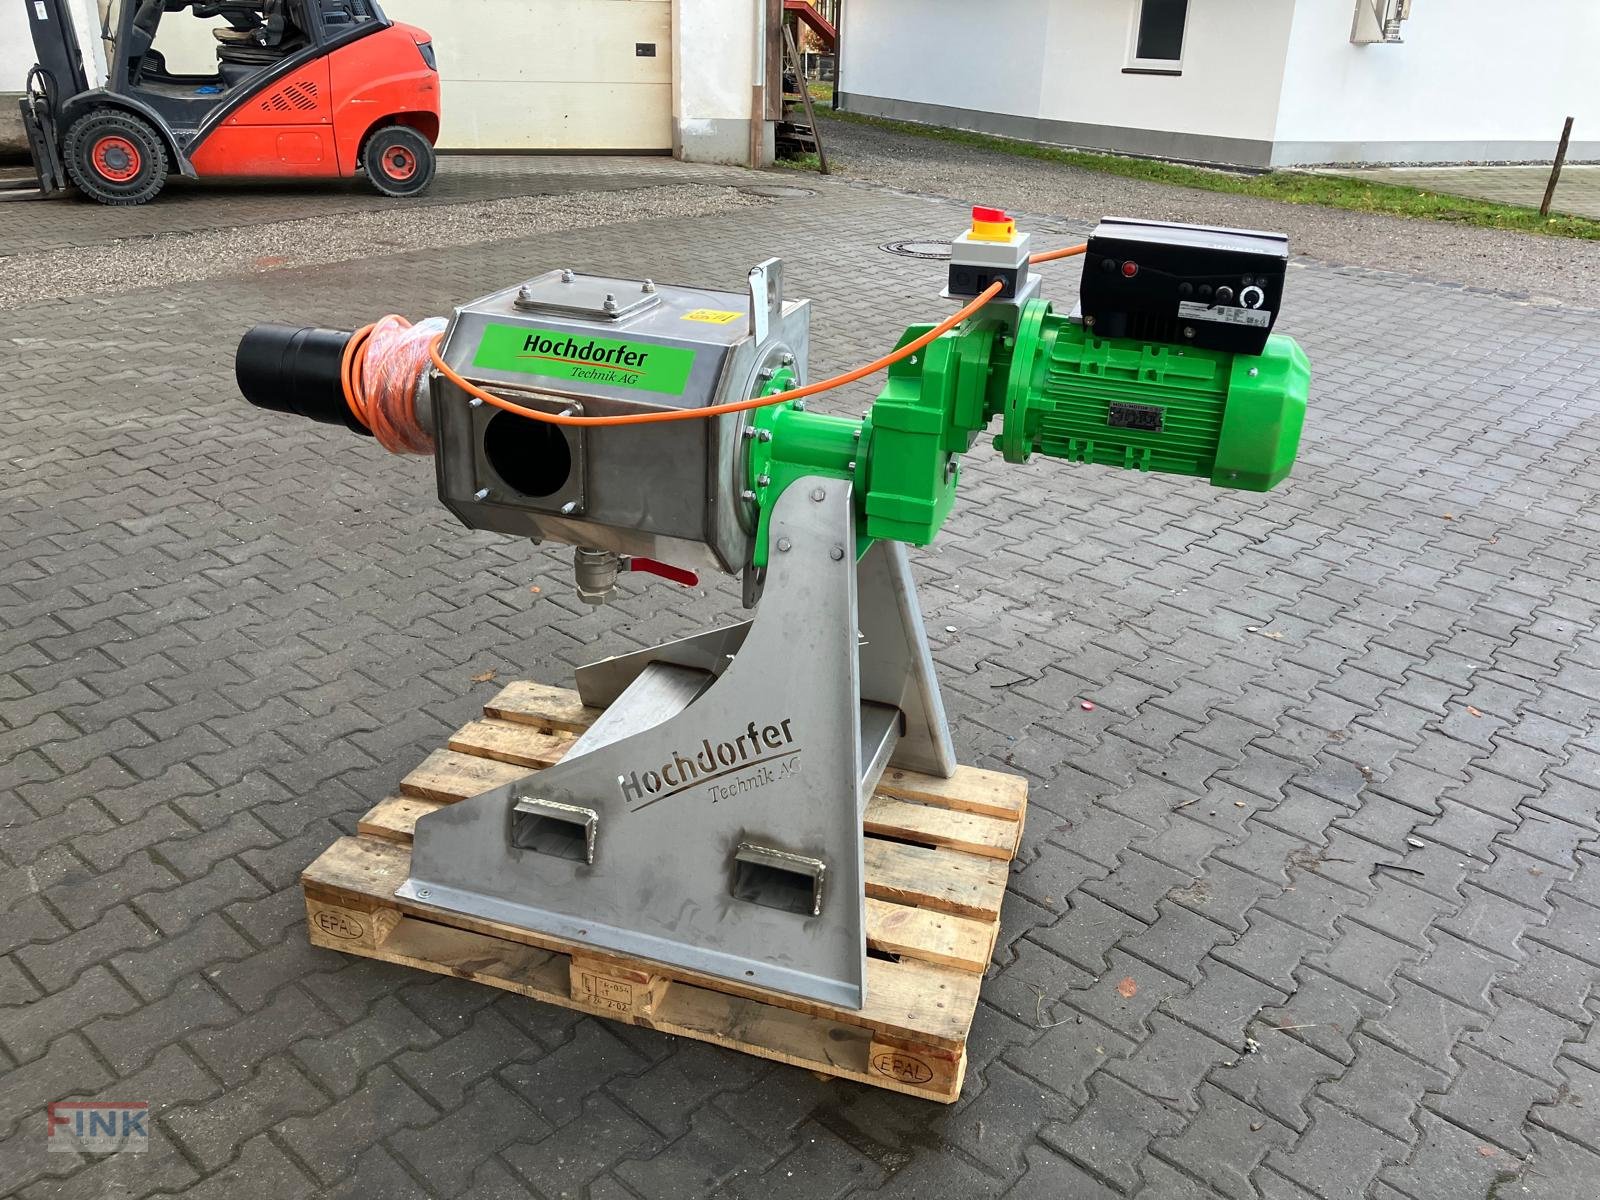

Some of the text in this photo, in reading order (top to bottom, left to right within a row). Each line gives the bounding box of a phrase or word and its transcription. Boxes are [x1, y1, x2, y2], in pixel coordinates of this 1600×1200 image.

[523, 334, 648, 367] Hochdorfer
[570, 366, 639, 385] Technik AG
[617, 718, 793, 803] Hochdorfer
[707, 756, 801, 803] Technik AG
[320, 914, 357, 937] EPAL
[880, 1056, 924, 1080] EPAL
